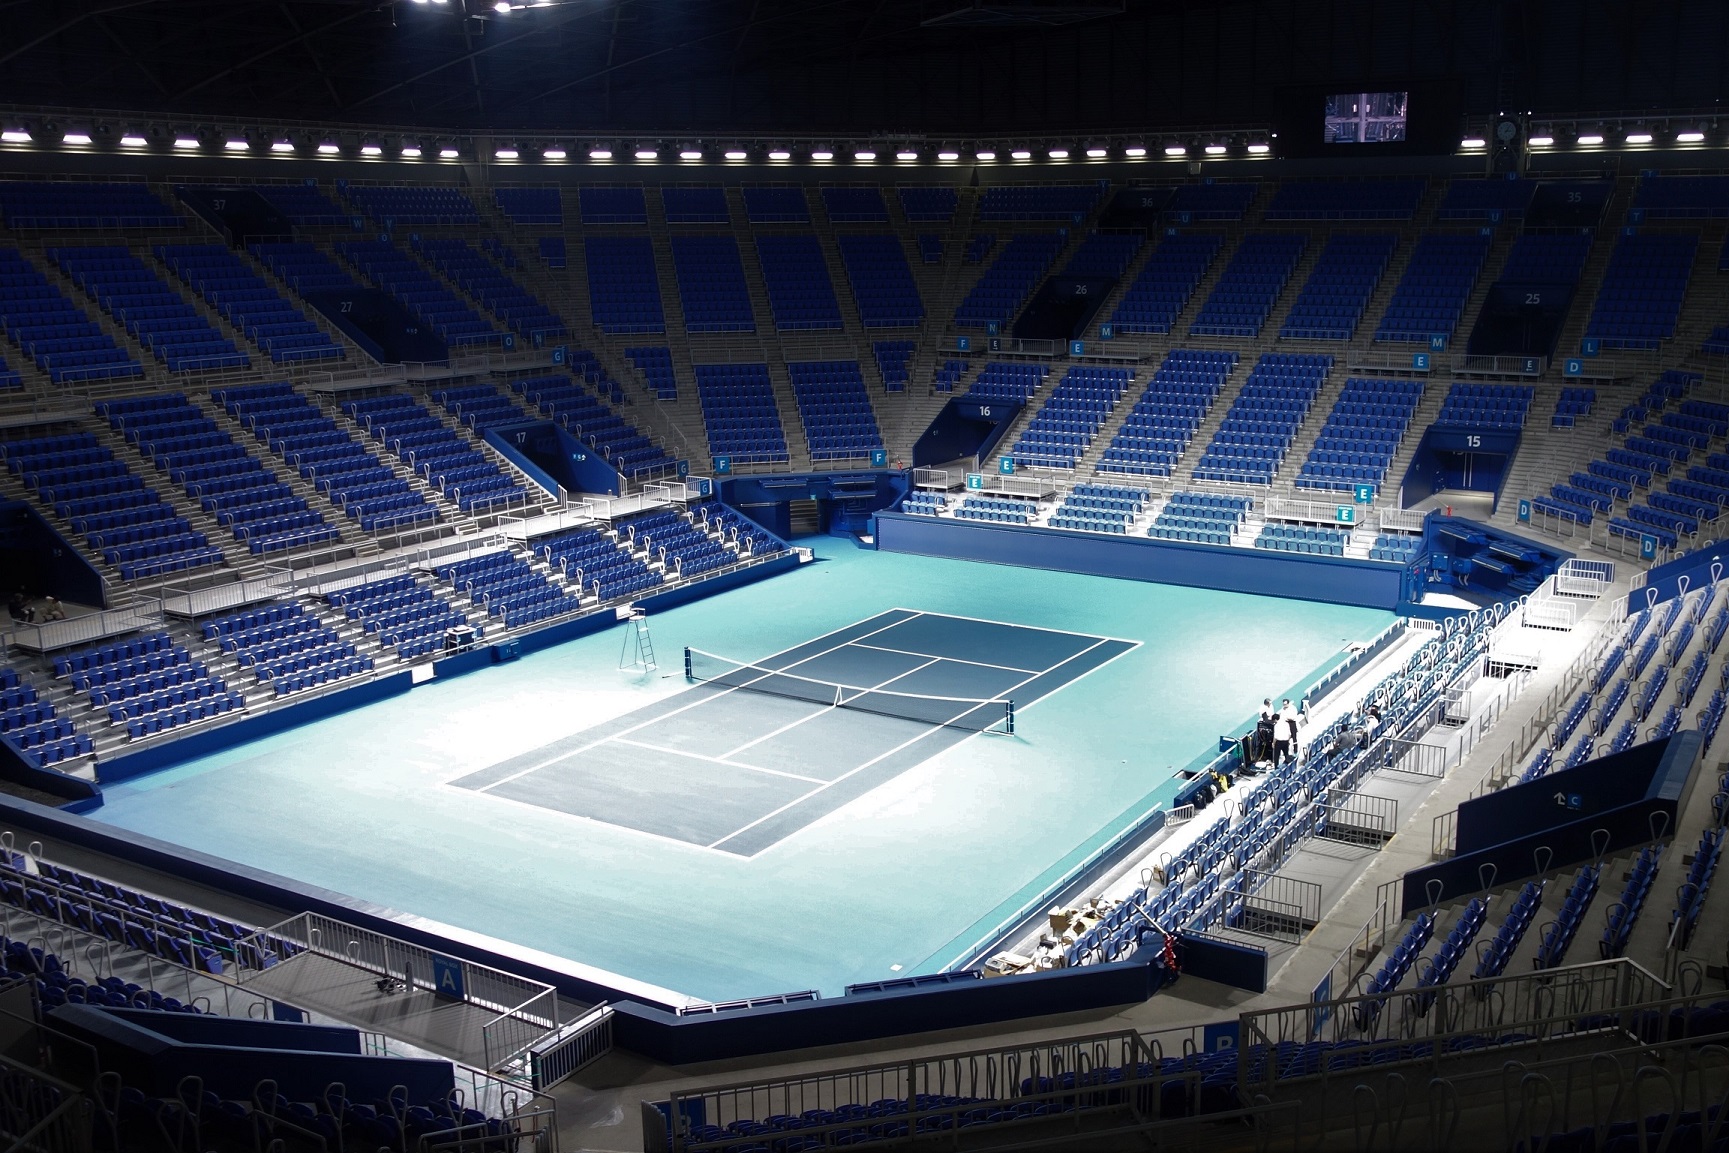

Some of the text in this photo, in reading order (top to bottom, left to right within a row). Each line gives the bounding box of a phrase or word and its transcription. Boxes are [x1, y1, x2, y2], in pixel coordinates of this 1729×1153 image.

[1568, 192, 1581, 203] 35
[213, 199, 226, 211] 37
[1142, 198, 1153, 207] 36
[1075, 215, 1081, 223] V
[1492, 213, 1499, 222] U
[1633, 213, 1640, 221] T
[354, 219, 362, 228] W
[387, 219, 392, 228] V
[1482, 228, 1490, 236] M
[1076, 285, 1087, 294] 26
[1525, 293, 1540, 304] 25
[340, 301, 353, 312] 27
[989, 324, 996, 332] N
[1102, 328, 1110, 336] M
[505, 337, 512, 346] O
[536, 334, 542, 343] N
[960, 339, 966, 347] F
[1432, 338, 1442, 347] M
[1075, 343, 1081, 352] E
[1587, 343, 1593, 352] L
[554, 352, 560, 361] G
[1418, 357, 1424, 366] E
[1528, 360, 1533, 368] E
[1570, 363, 1578, 372] D
[980, 406, 991, 416] 16
[516, 432, 526, 443] 17
[1467, 435, 1481, 447] 15
[876, 453, 882, 462] F
[681, 464, 687, 473] G
[720, 460, 726, 469] F
[1004, 461, 1010, 470] E
[972, 478, 978, 488] E
[702, 484, 708, 493] G
[1359, 489, 1366, 499] E
[1521, 505, 1527, 515] D
[1341, 510, 1348, 520] E
[1645, 542, 1652, 552] D
[1571, 796, 1578, 805] C
[442, 968, 457, 991] A
